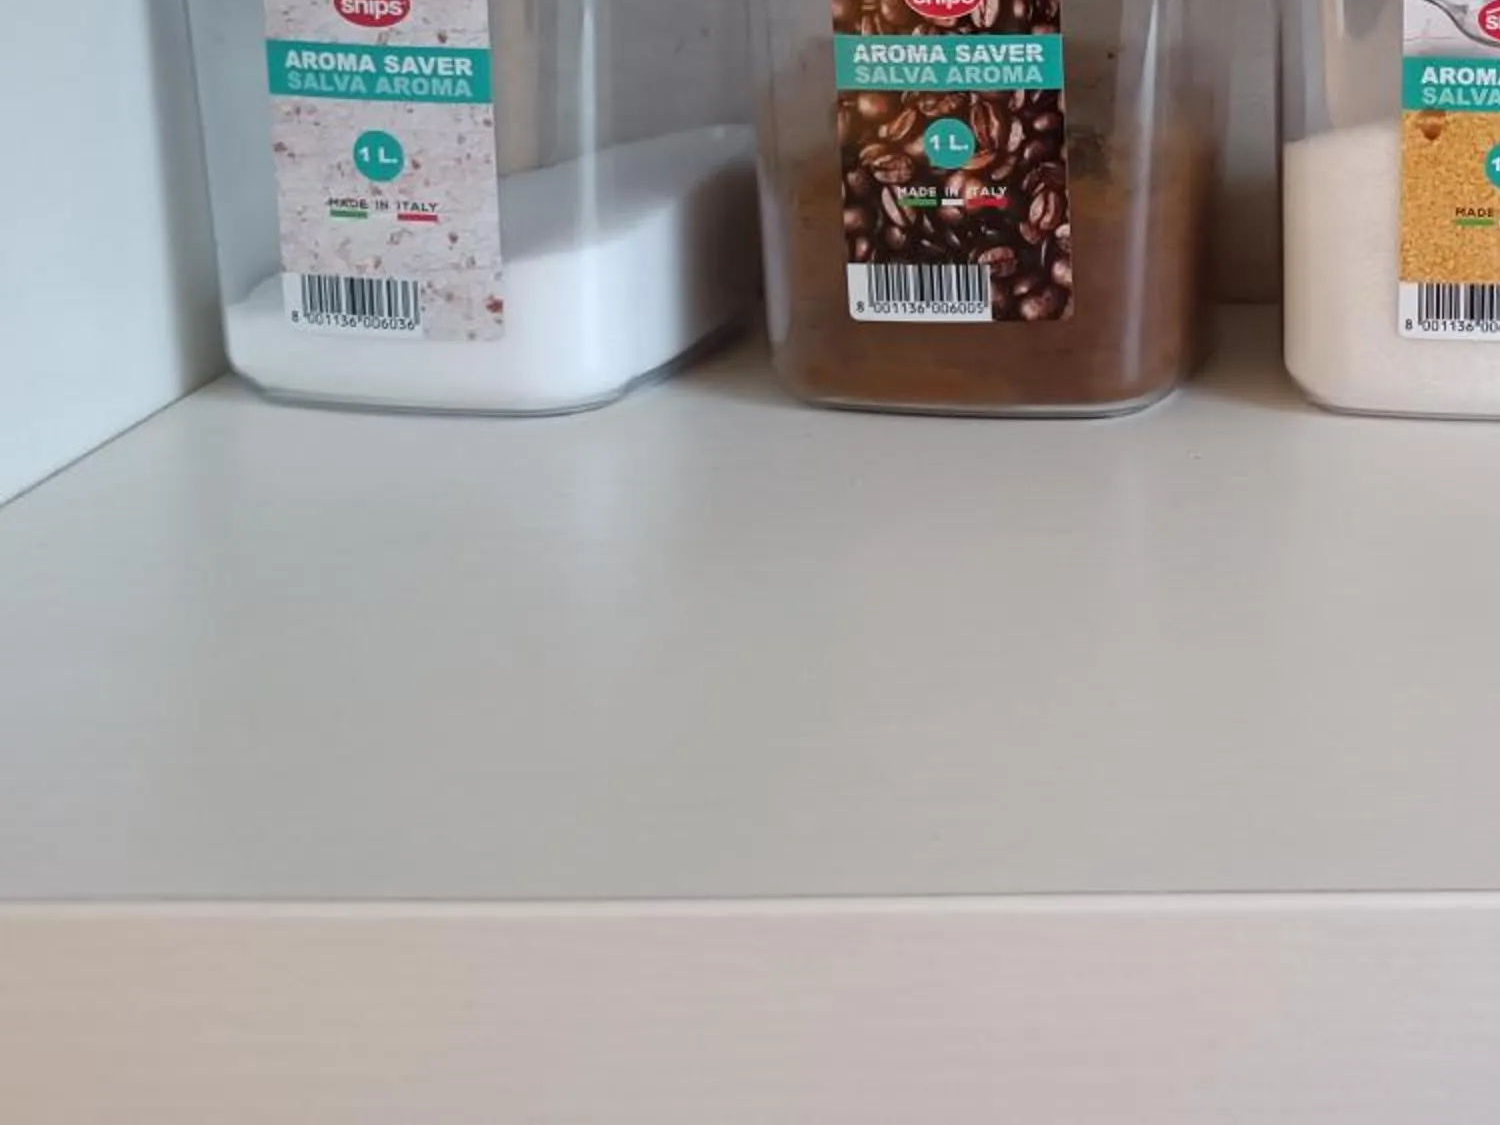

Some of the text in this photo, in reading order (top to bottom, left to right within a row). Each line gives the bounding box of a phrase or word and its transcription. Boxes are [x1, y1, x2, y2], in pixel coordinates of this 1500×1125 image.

[853, 42, 1045, 64] AROMA SAVER
[284, 49, 474, 76] AROMA SAVER
[855, 64, 1044, 84] SALVA AROMA
[286, 70, 473, 97] SALVA AROMA
[929, 134, 940, 151] 1
[359, 146, 370, 163] 1
[897, 186, 1008, 198] MADE IN ITALY
[327, 197, 438, 213] MADE IN ITALY
[1455, 206, 1495, 218] MADE
[855, 300, 865, 313] 8
[291, 310, 300, 324] 8
[1404, 318, 1413, 331] 8
